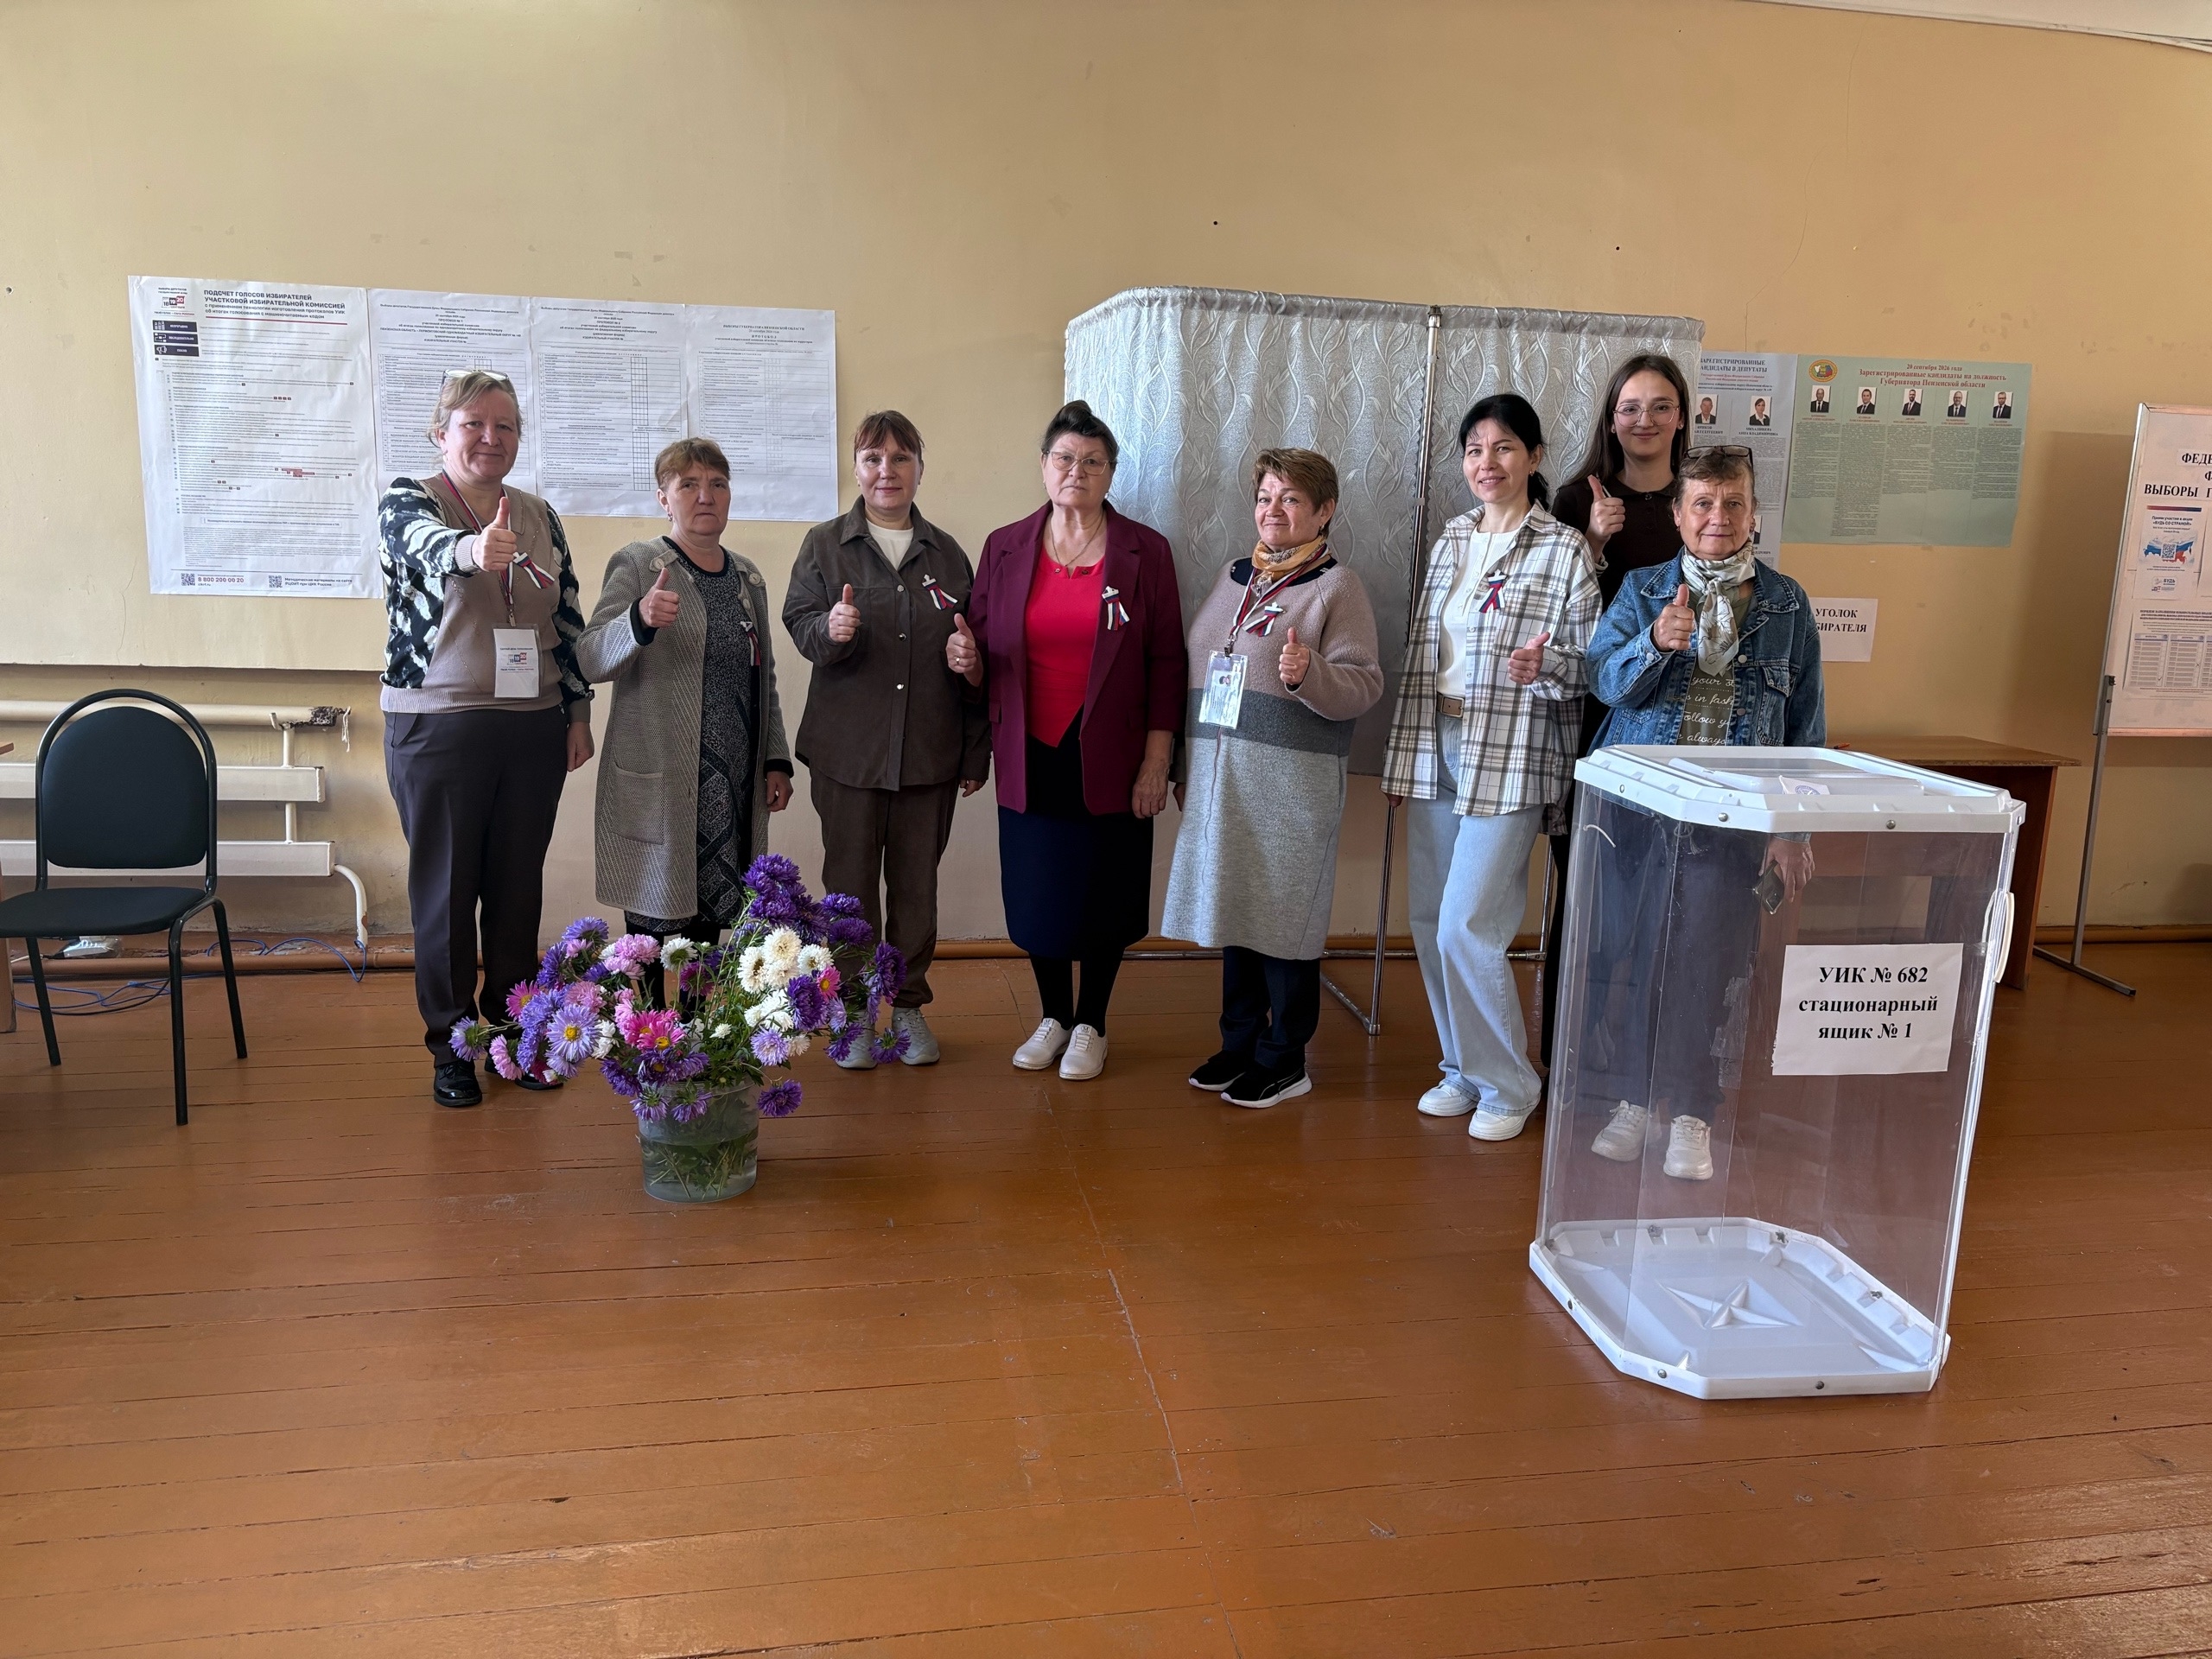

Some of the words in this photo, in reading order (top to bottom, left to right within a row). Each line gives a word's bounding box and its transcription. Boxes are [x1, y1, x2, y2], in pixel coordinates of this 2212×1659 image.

[1860, 369, 1926, 378] Зарегистрированные
[1880, 378, 1920, 386] Губернатора
[2144, 484, 2198, 497] ВЫБОРЫ
[1816, 608, 1858, 618] УГОЛОК
[1691, 677, 1721, 685] your
[1695, 694, 1707, 702] in
[1819, 967, 1866, 983] УИК
[1870, 967, 1892, 983] №
[1897, 966, 1928, 983] 682
[1798, 996, 1938, 1016] стационарный
[1818, 1027, 1873, 1040] ящик
[1877, 1023, 1898, 1039] №
[1905, 1023, 1912, 1038] 1
